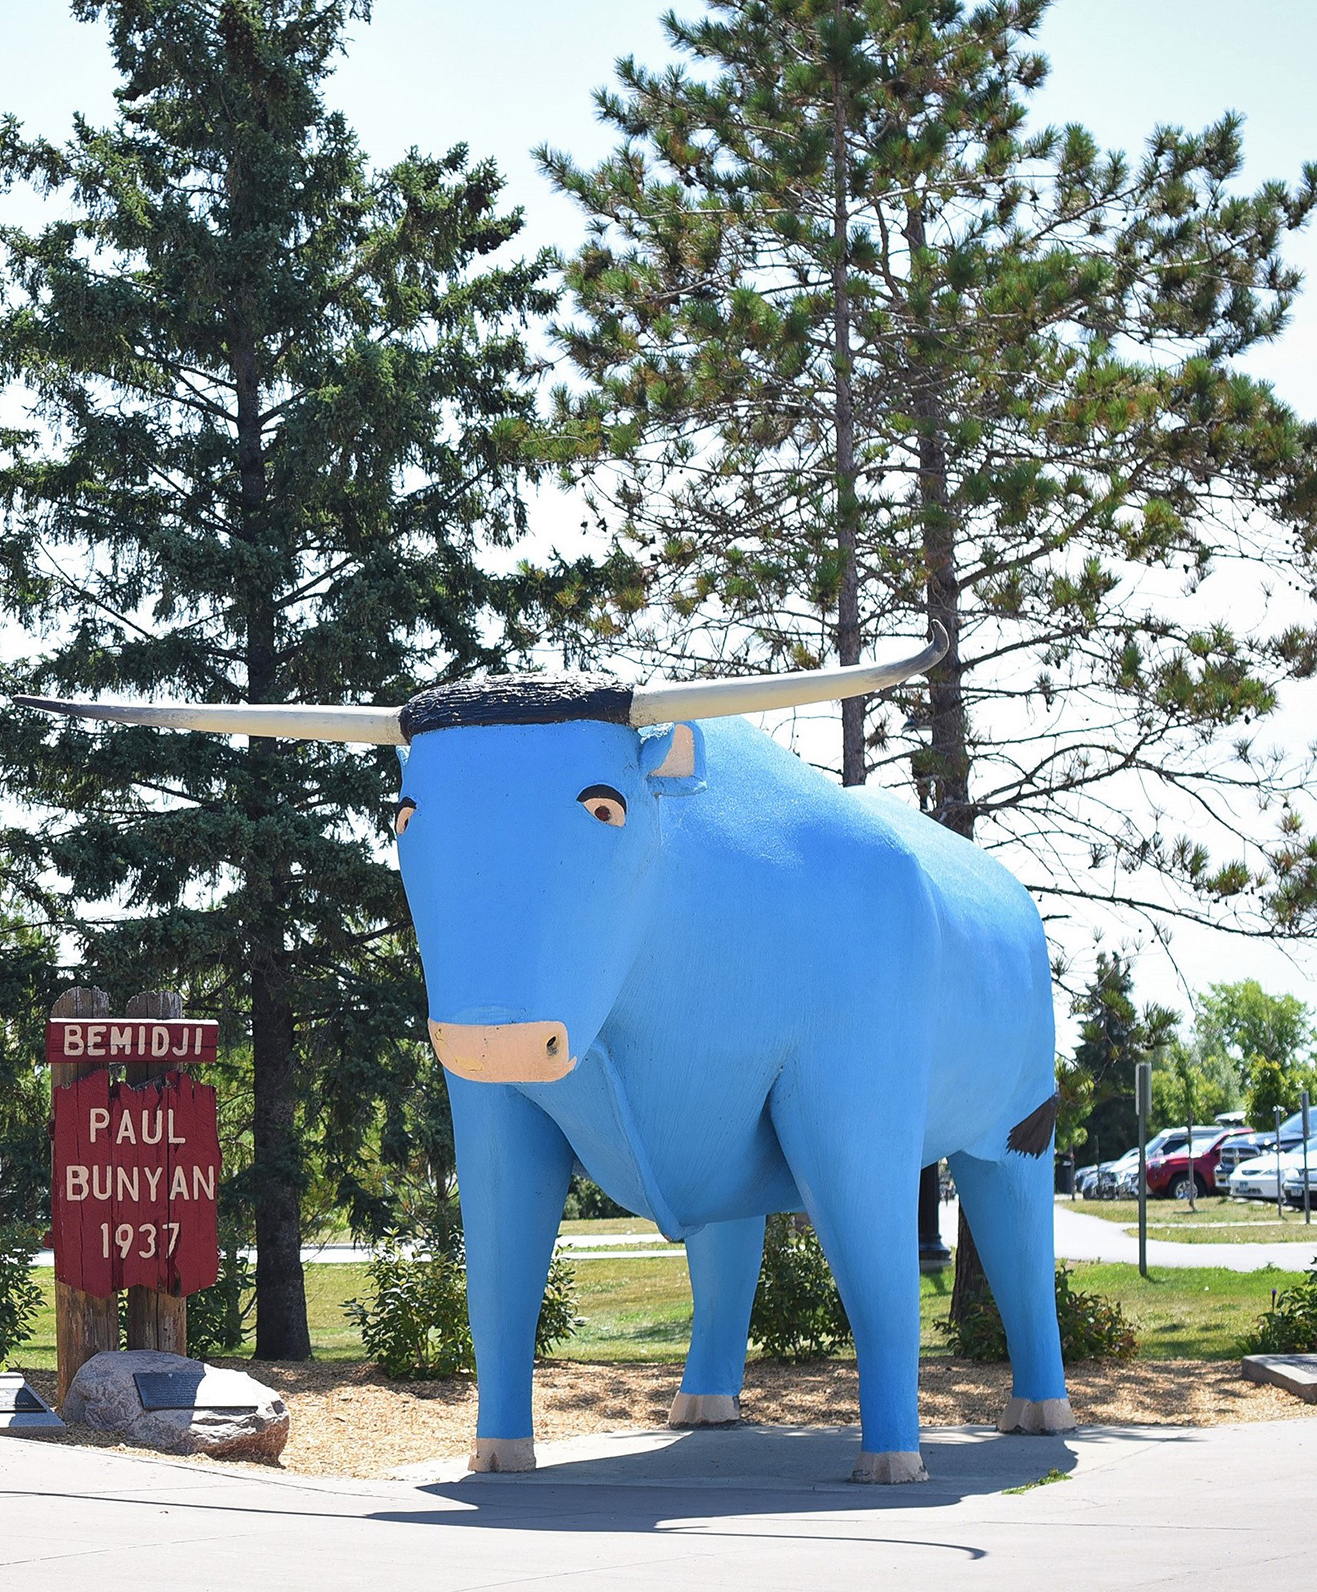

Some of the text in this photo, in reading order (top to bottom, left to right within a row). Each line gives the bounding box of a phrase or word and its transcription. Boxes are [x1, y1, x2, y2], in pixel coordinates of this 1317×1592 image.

[63, 1024, 203, 1057] BEMIDJI
[89, 1107, 186, 1145] PAUL
[65, 1165, 216, 1202] BUNYAN
[100, 1222, 180, 1259] 1937
